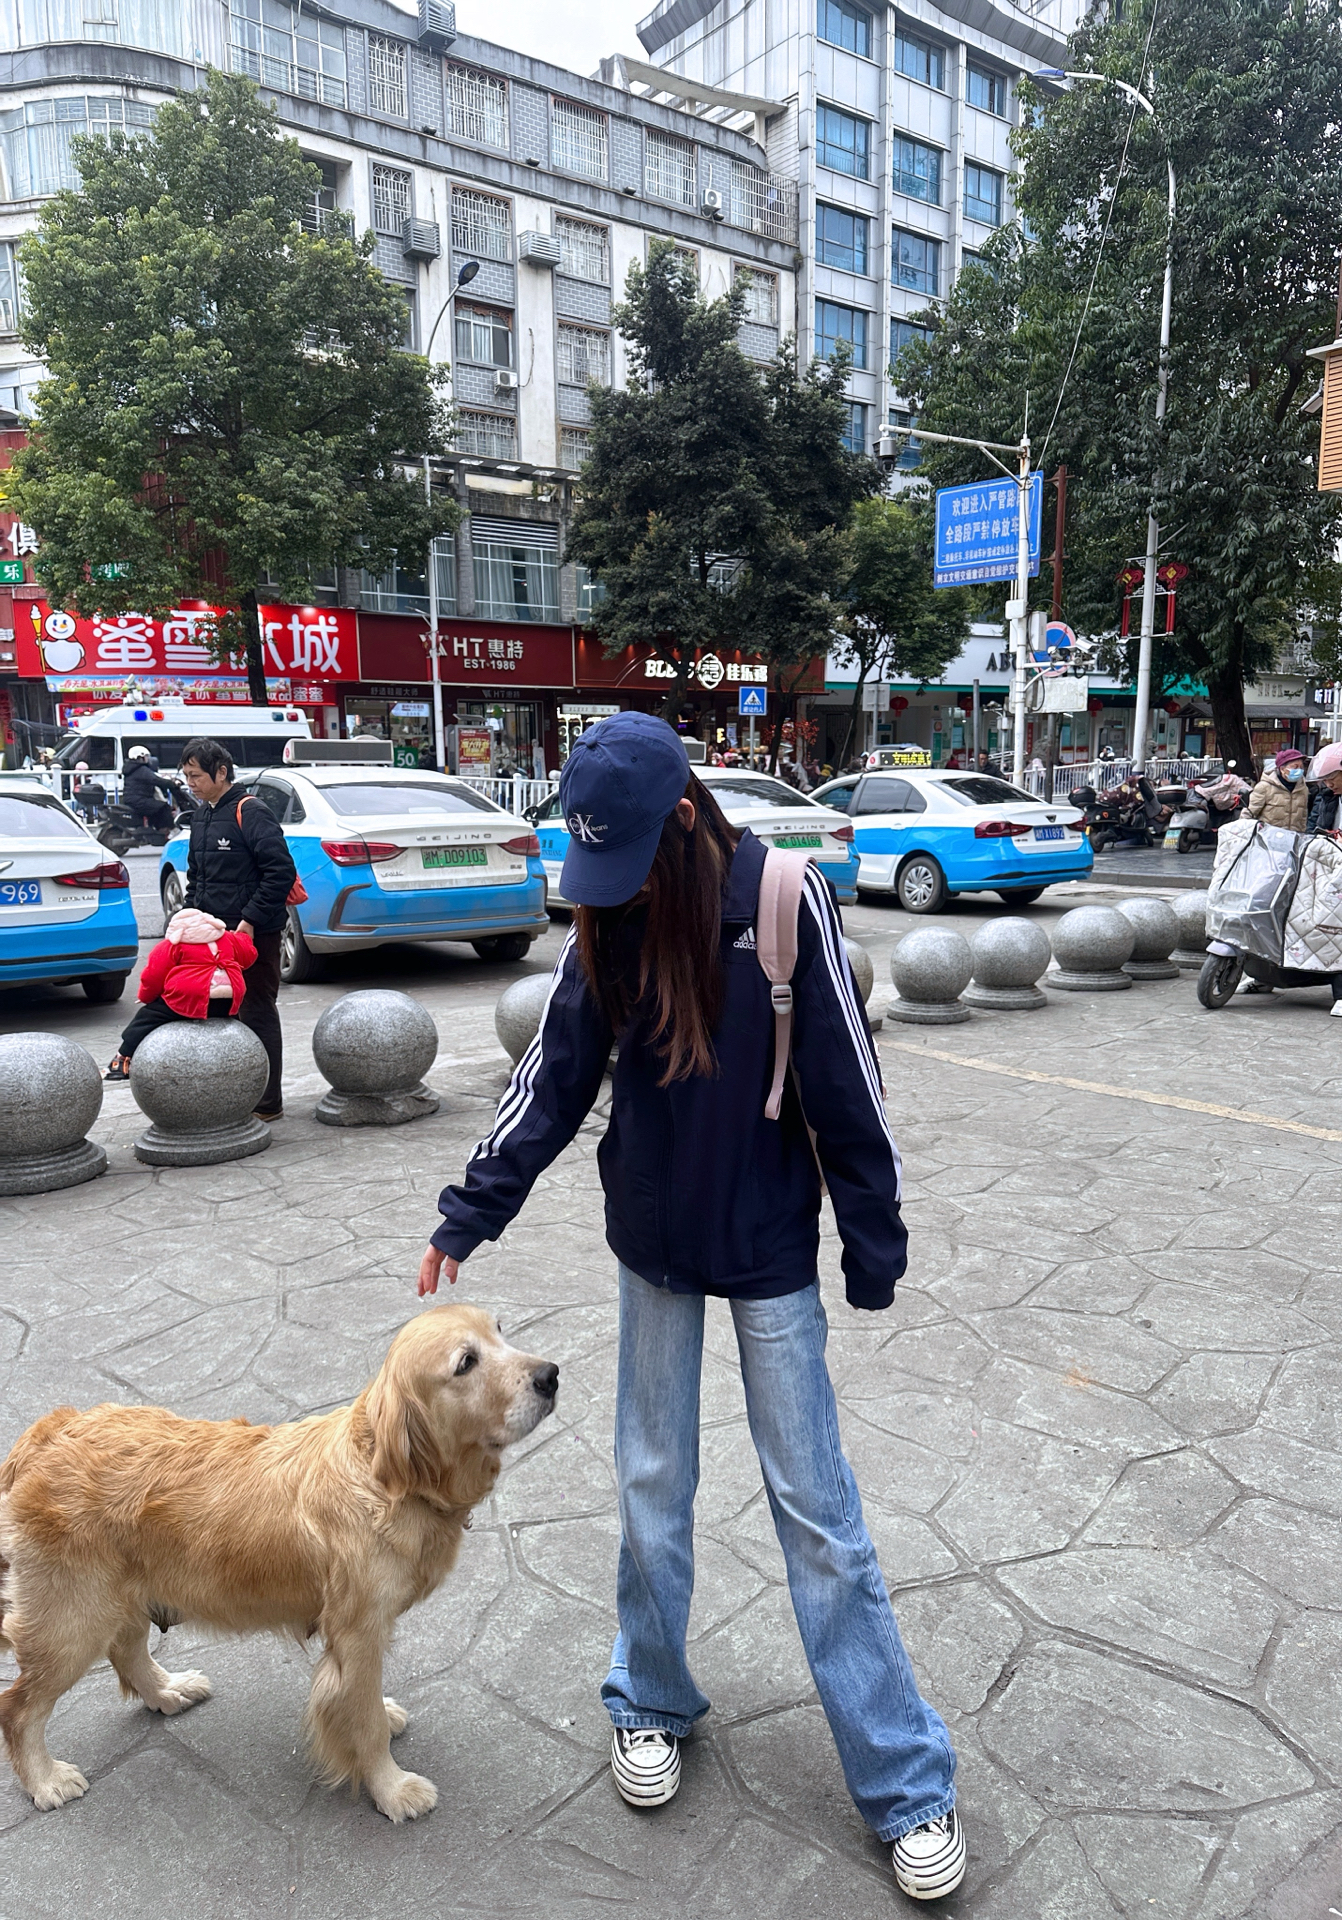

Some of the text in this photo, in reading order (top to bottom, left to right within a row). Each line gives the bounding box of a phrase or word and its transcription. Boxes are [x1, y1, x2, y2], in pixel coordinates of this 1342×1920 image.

[945, 516, 1020, 544] 全路段严禁停放车
[397, 752, 415, 767] 50
[1, 884, 39, 902] 969
